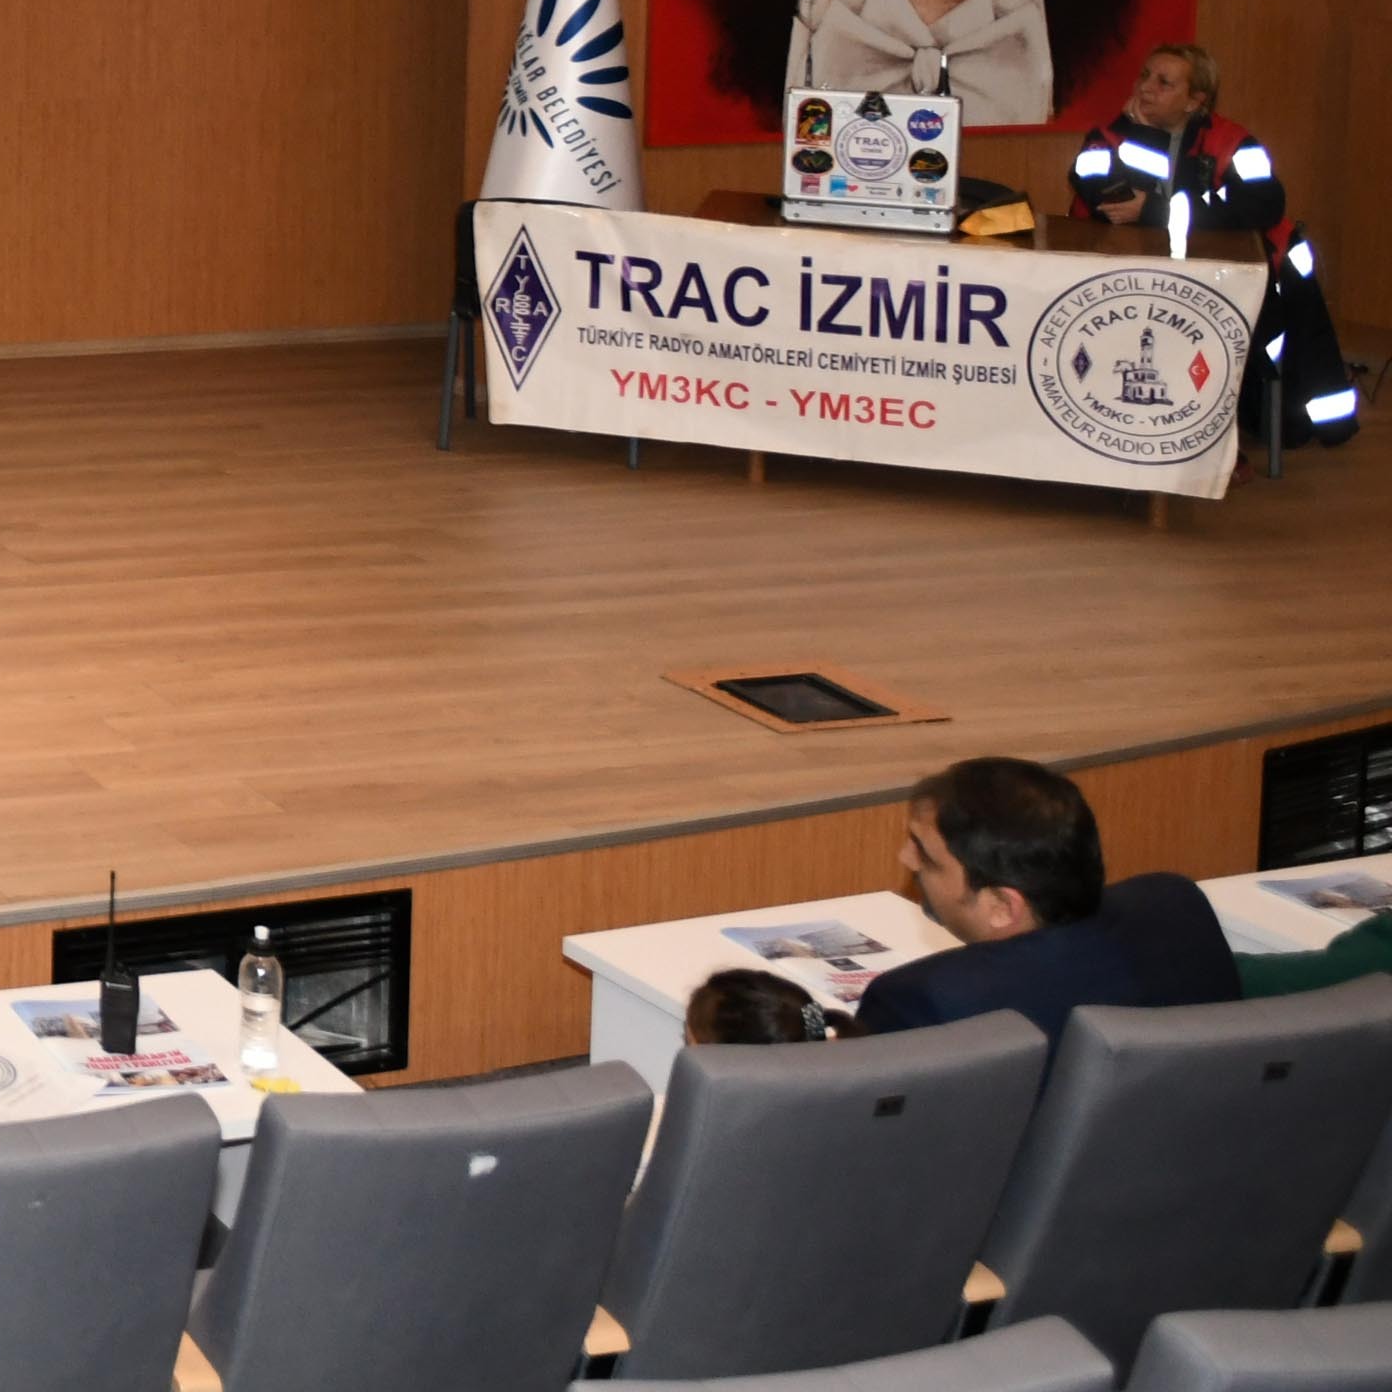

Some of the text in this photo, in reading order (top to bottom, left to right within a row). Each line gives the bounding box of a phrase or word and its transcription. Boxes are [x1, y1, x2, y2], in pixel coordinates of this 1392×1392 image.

[536, 85, 622, 195] BELEDİYESİ
[854, 137, 889, 147] TRAC
[575, 250, 1010, 348] TRAC İZMİR
[1040, 305, 1073, 348] AFET
[1070, 288, 1098, 307] VE
[1101, 274, 1144, 295] ACİL
[1079, 303, 1204, 346] TRAC İZMİR
[576, 325, 1017, 386] TÜRKİYE RADYO AMATÖRLERİ CEMİYETİ İZMİR ŞUBESİ
[610, 368, 751, 411] YM3KC
[789, 388, 936, 430] YM3EC
[1040, 372, 1238, 455] AMATEUR RADIO EMERGENCY
[1082, 391, 1134, 426] YM3KC
[1148, 399, 1201, 427] YM3EC
